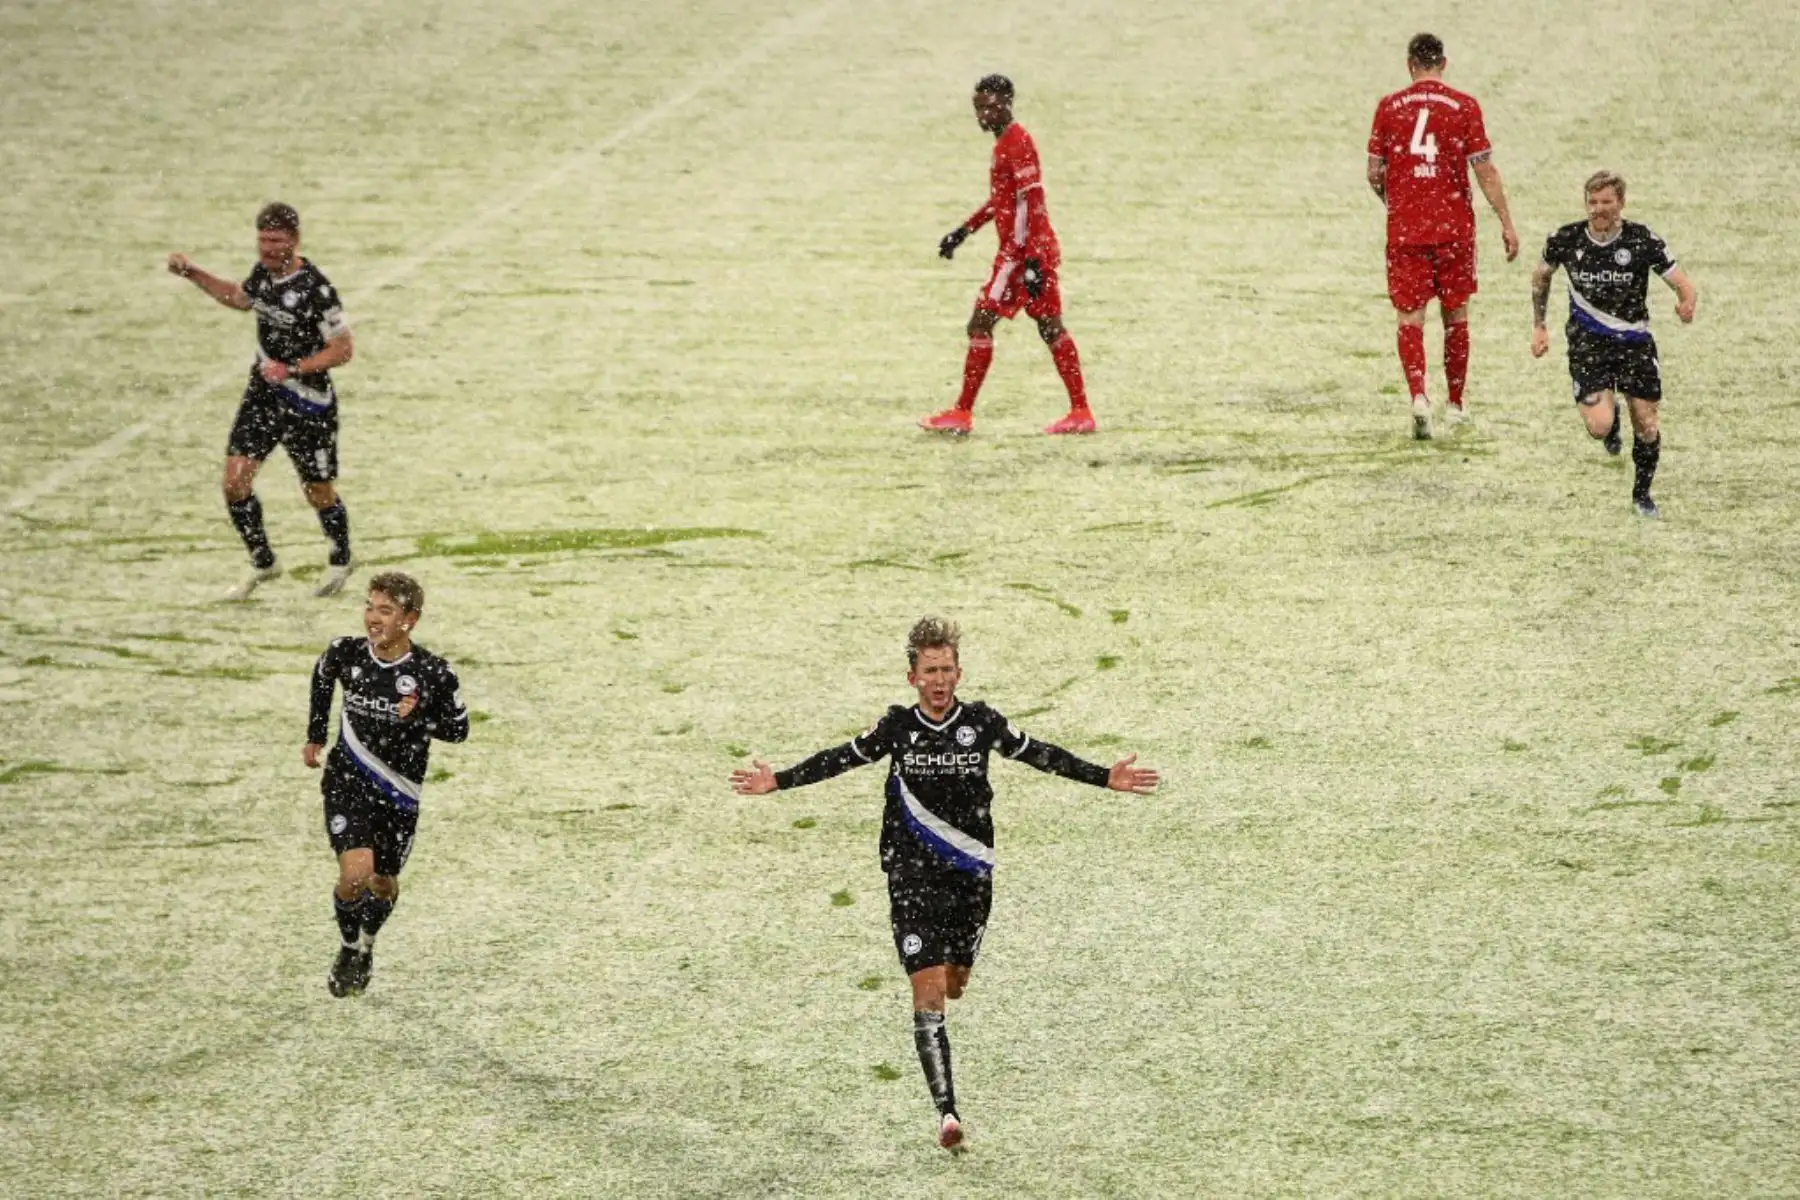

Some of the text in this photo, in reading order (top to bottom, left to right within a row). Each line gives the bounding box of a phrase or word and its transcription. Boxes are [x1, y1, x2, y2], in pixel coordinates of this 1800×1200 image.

[1410, 108, 1438, 163] 4
[343, 689, 400, 715] SCHÜC
[903, 752, 981, 766] SCHÜCO
